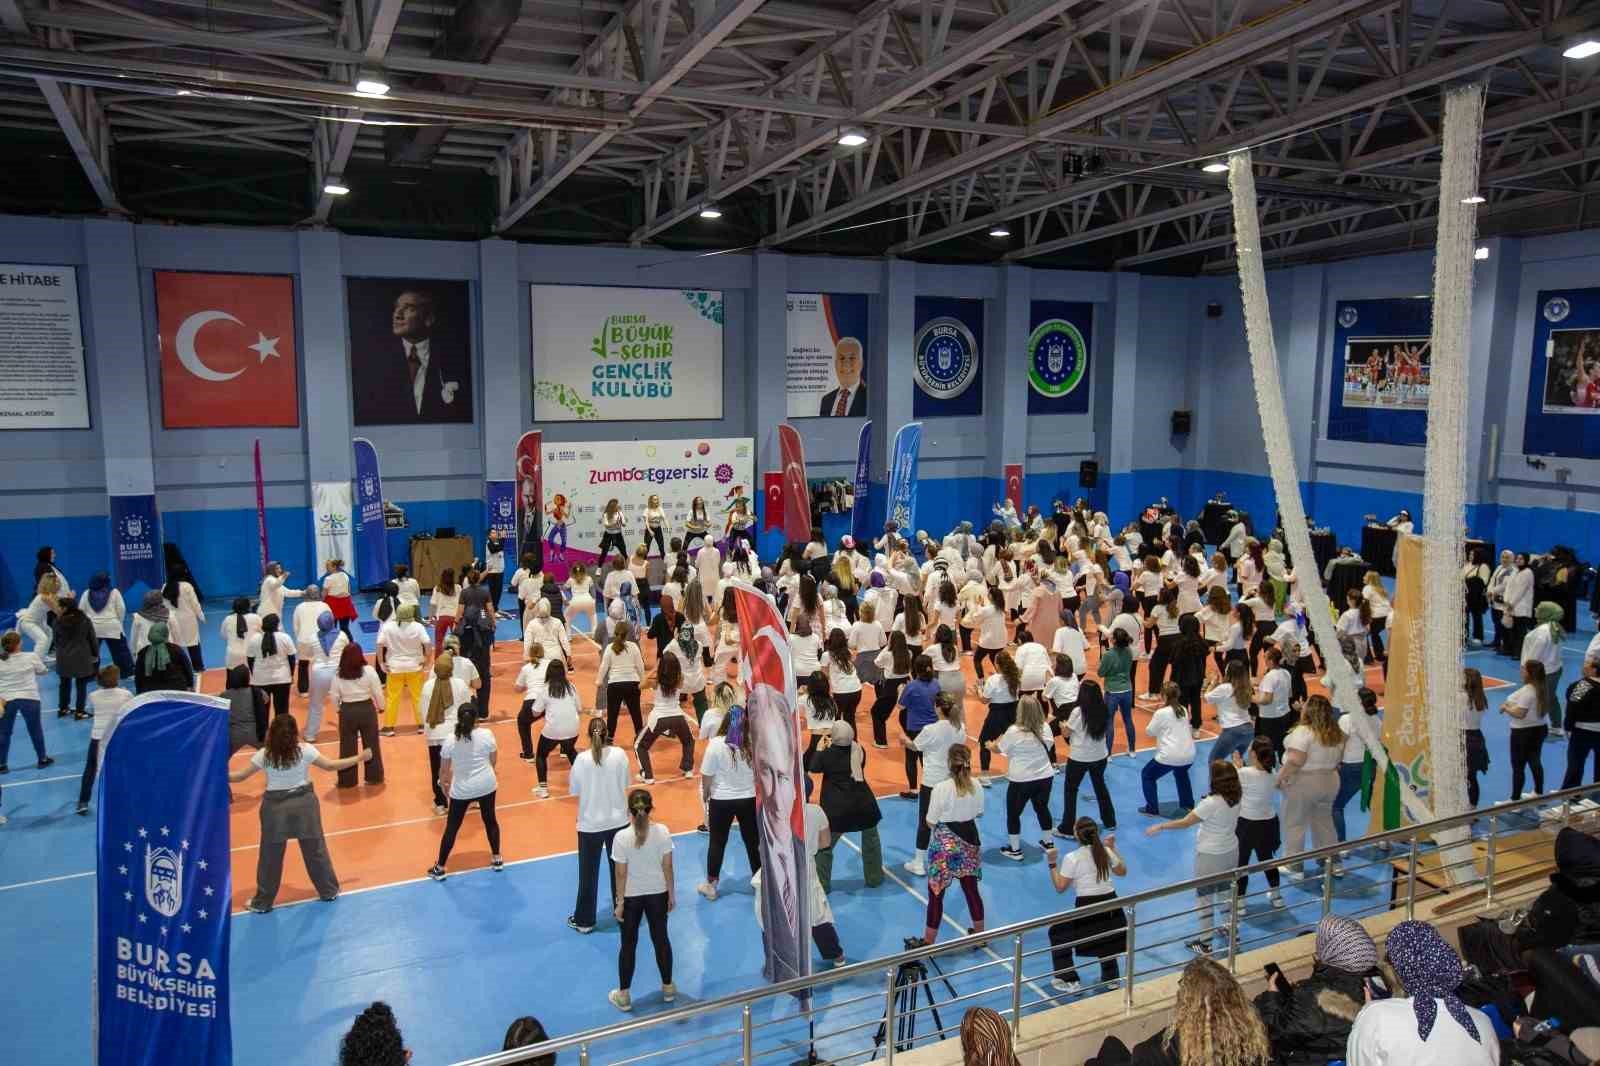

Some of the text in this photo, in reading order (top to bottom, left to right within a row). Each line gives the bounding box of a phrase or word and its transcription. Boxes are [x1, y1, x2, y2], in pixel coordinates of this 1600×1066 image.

[10, 272, 61, 287] HİTABE
[592, 361, 673, 380] GENÇLİK
[592, 380, 673, 398] KULÜBÜ
[589, 467, 644, 484] Zumba
[648, 464, 709, 484] Egzersiz
[116, 937, 217, 981] BURSA
[116, 961, 217, 999] BÜYÜKŞEHİR
[116, 983, 217, 1019] BELEDİYESİ
